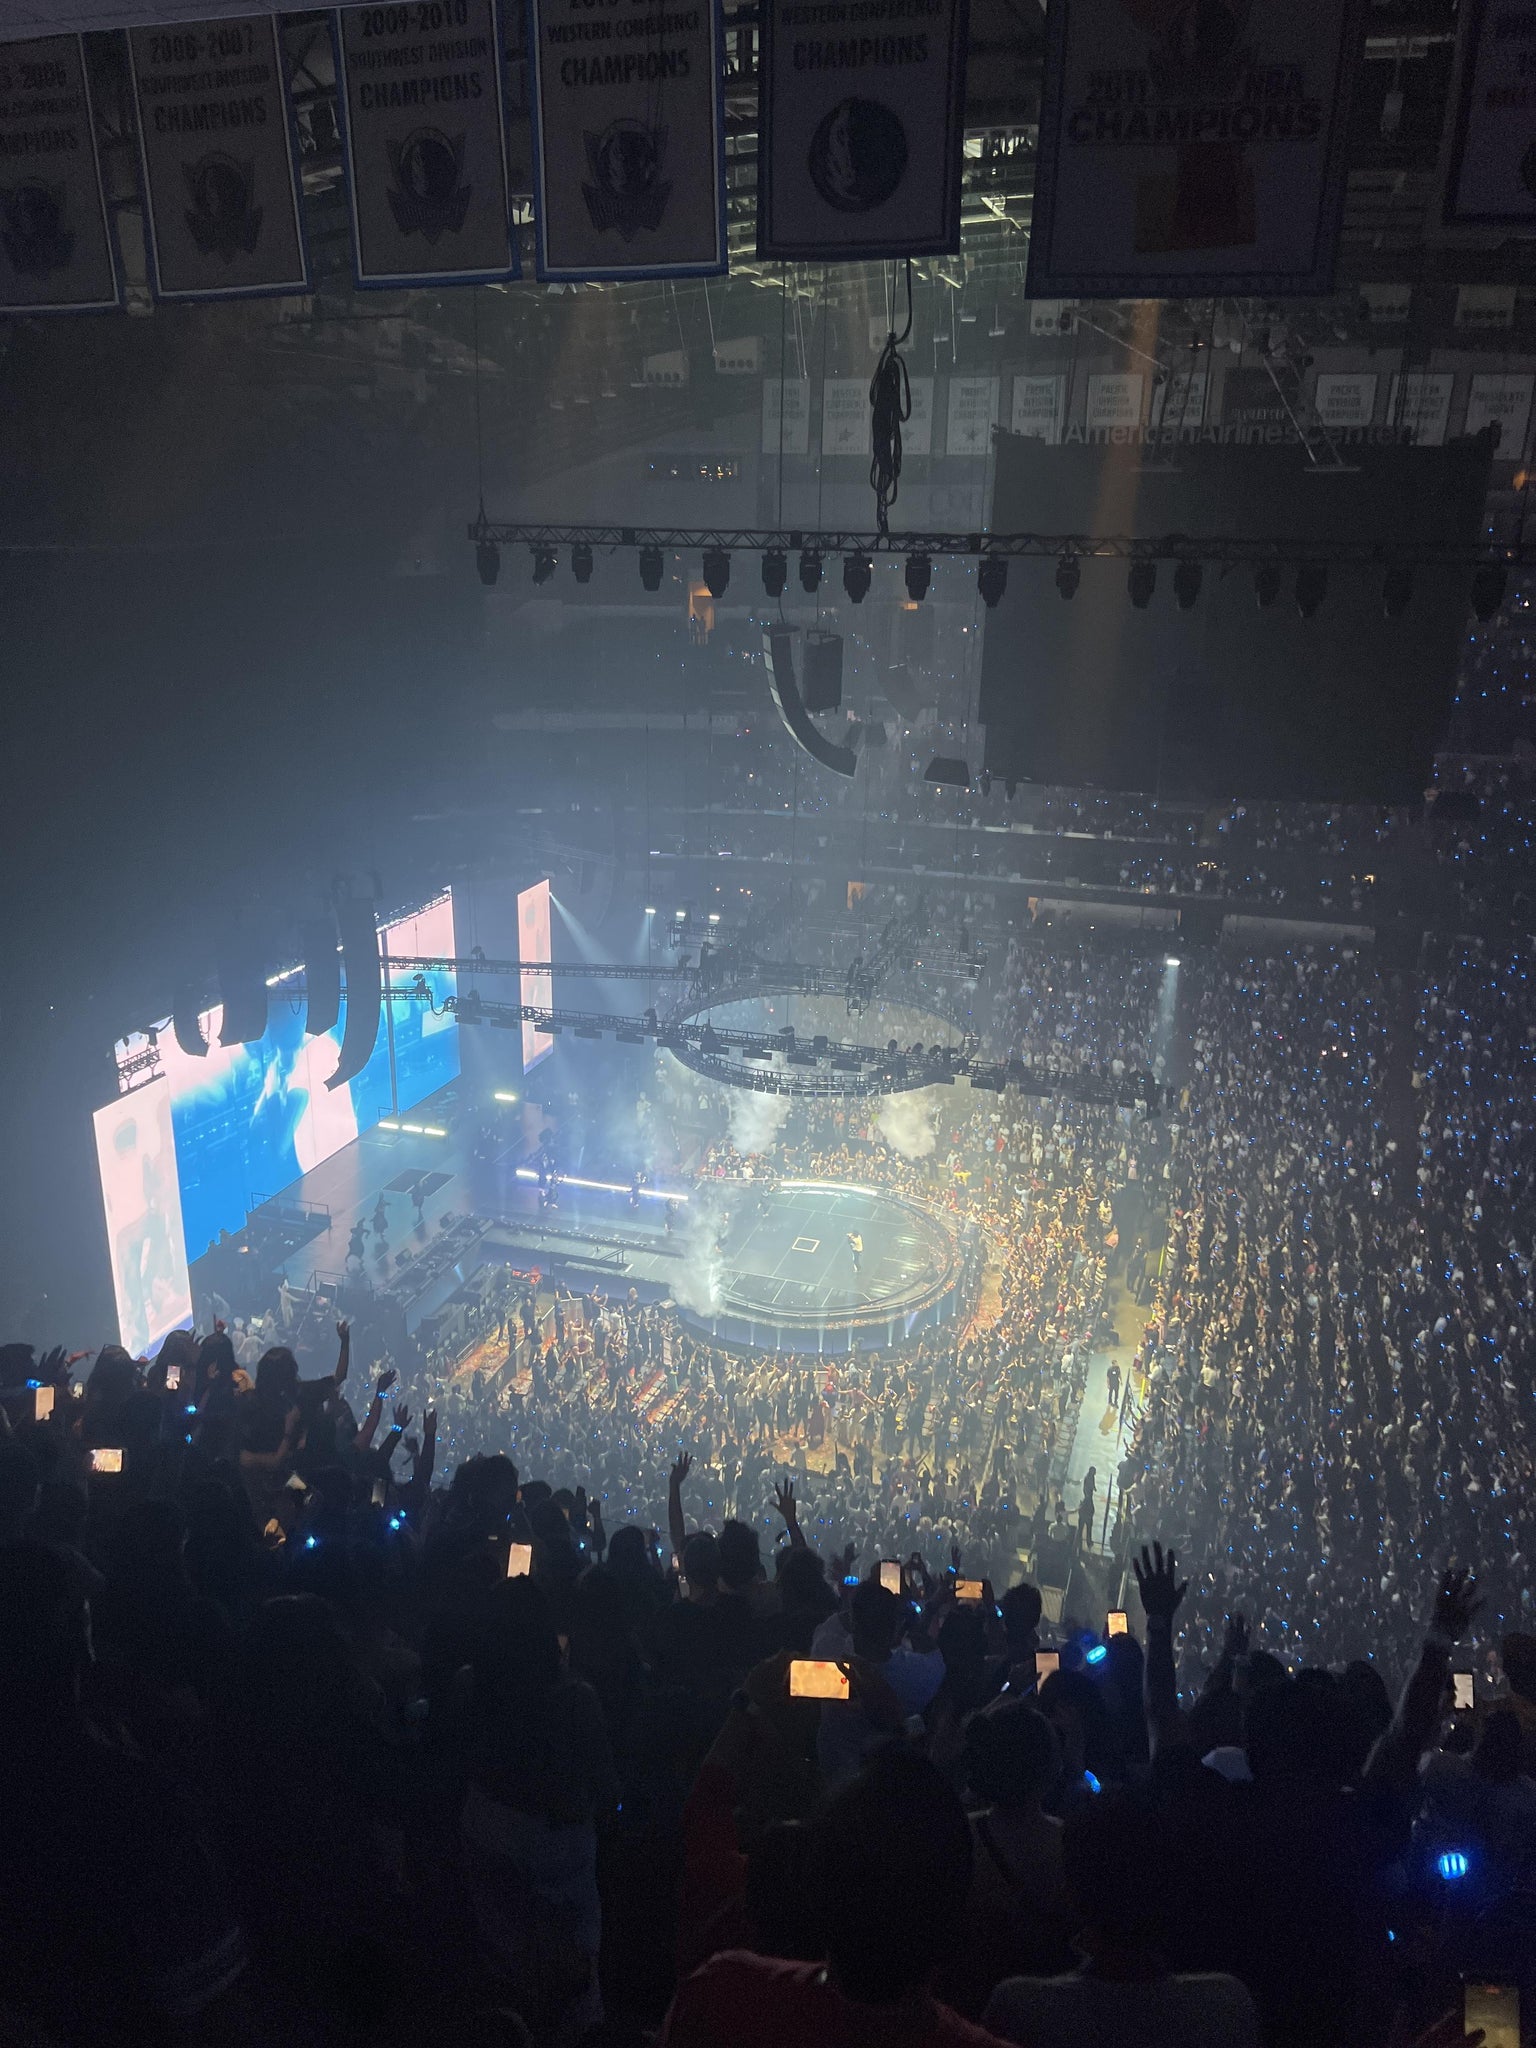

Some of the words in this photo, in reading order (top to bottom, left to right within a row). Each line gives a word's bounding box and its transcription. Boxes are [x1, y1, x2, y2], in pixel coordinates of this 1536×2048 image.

[428, 37, 488, 62] DIVISION
[546, 21, 612, 43] WESTERN
[561, 49, 691, 87] CHAMPIONS
[793, 33, 929, 70] CHAMPIONS
[360, 72, 482, 109] CHAMPIONS
[154, 97, 267, 132] CHAMPIONS
[1067, 104, 1323, 142] CHAMPIONS
[1064, 420, 1197, 446] American
[1198, 420, 1301, 446] Airlines
